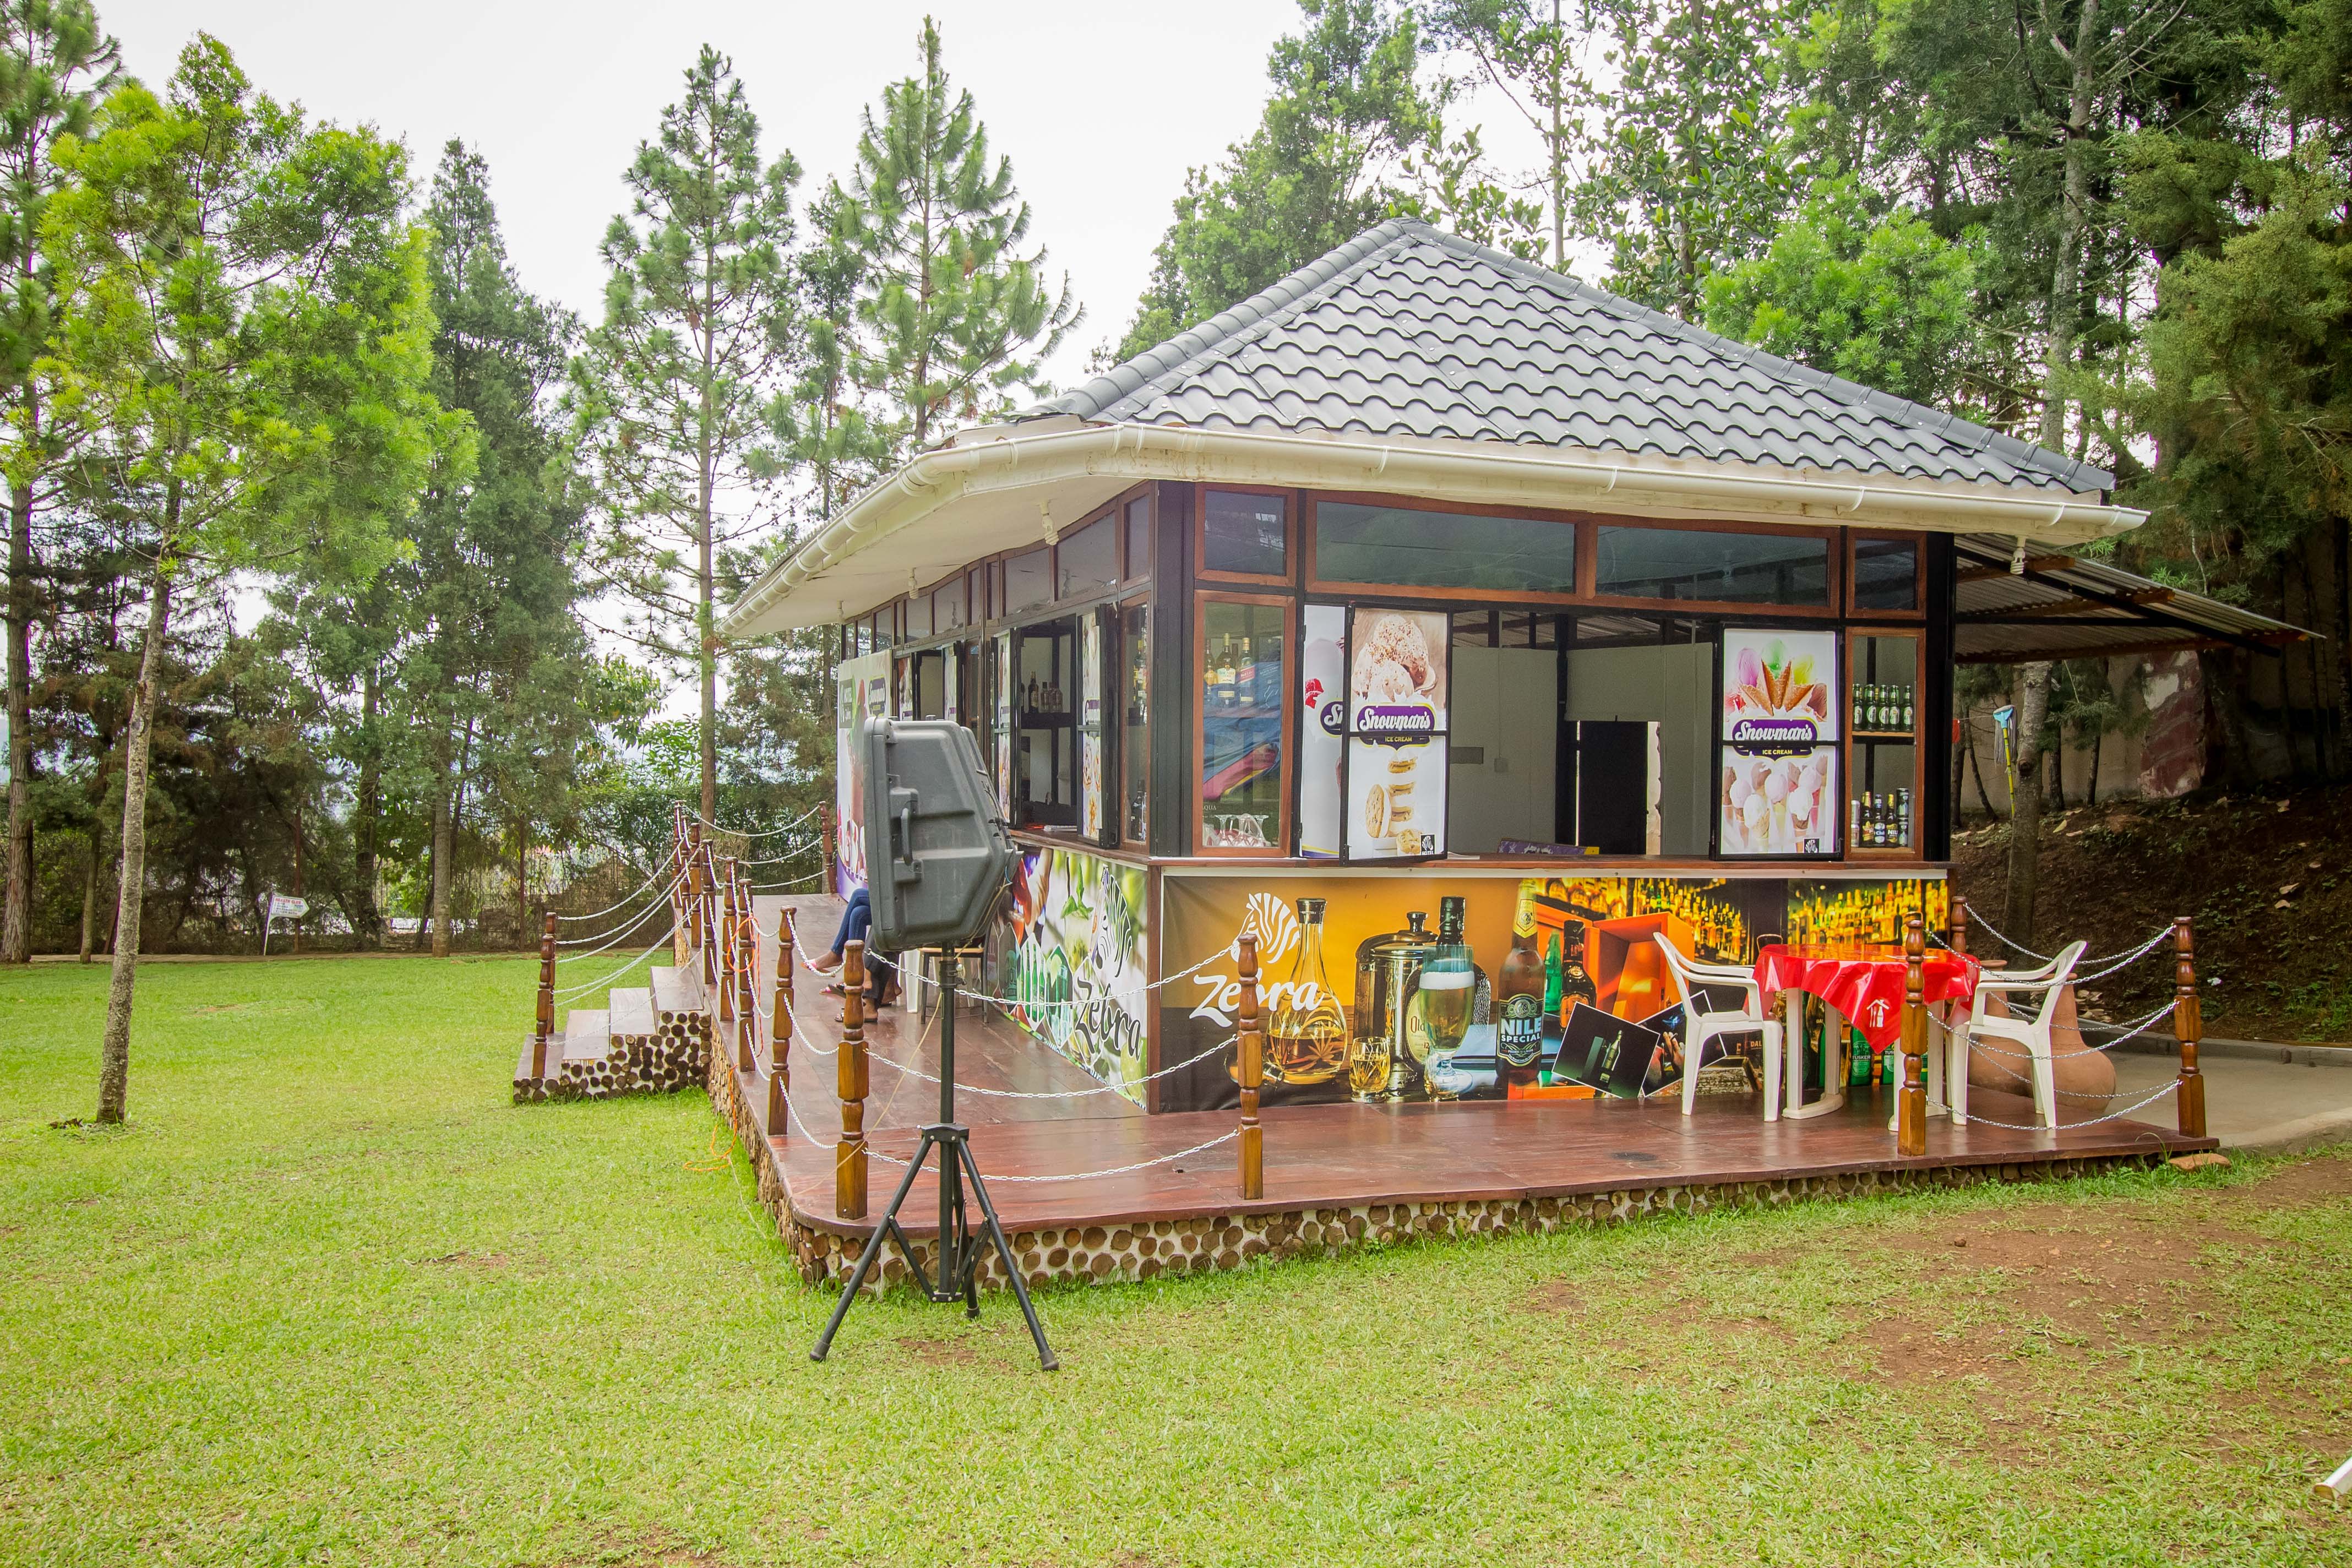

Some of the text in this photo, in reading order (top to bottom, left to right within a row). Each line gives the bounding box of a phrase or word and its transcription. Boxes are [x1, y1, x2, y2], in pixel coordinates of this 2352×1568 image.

[1359, 708, 1431, 731] Snowman's
[1735, 721, 1812, 741] Snowman's
[1075, 977, 1142, 1061] Zebra
[1411, 1016, 1425, 1033] Old
[1501, 1016, 1542, 1036] NILE
[1501, 1032, 1540, 1043] SPECIAL
